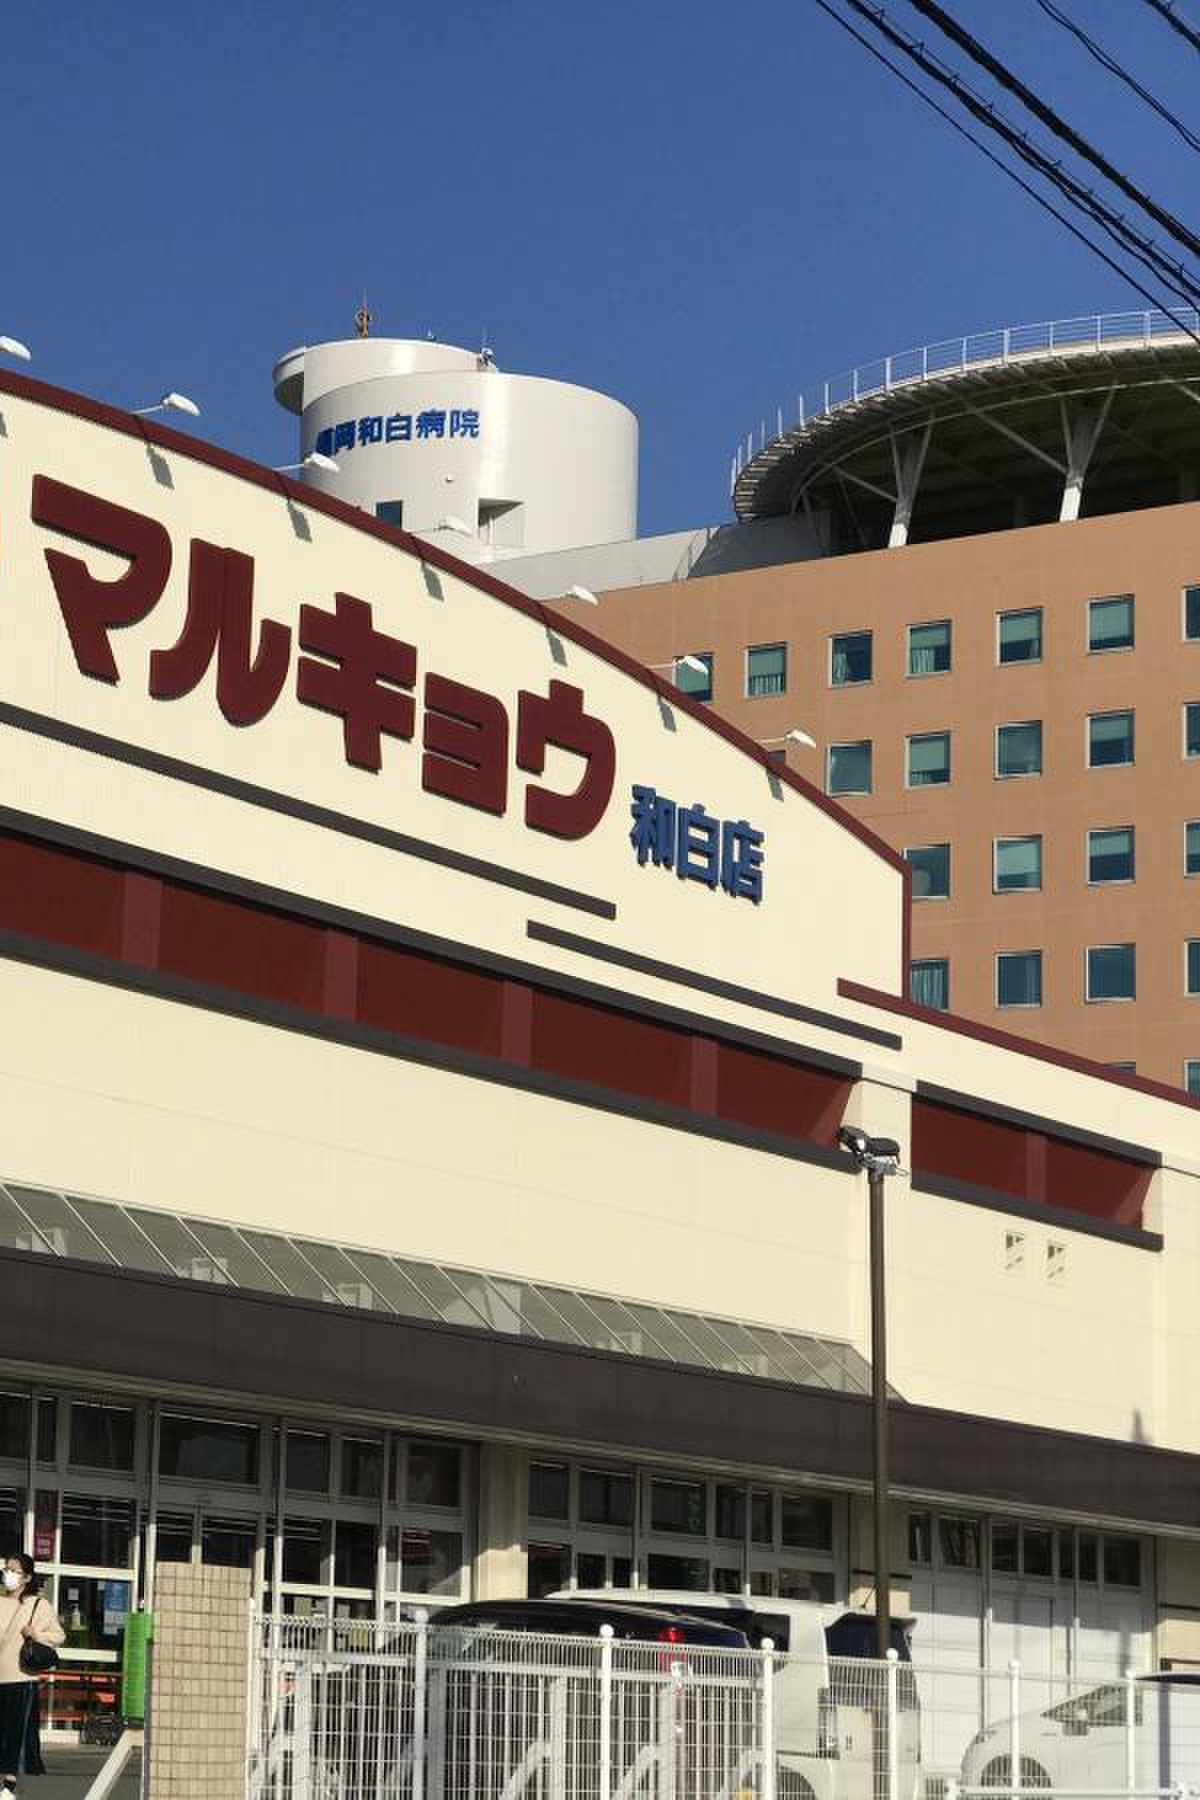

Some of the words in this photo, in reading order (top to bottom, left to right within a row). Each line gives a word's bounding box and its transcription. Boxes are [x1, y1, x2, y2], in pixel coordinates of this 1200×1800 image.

[31, 473, 616, 841] マルキョウ
[629, 783, 765, 907] 和白店
